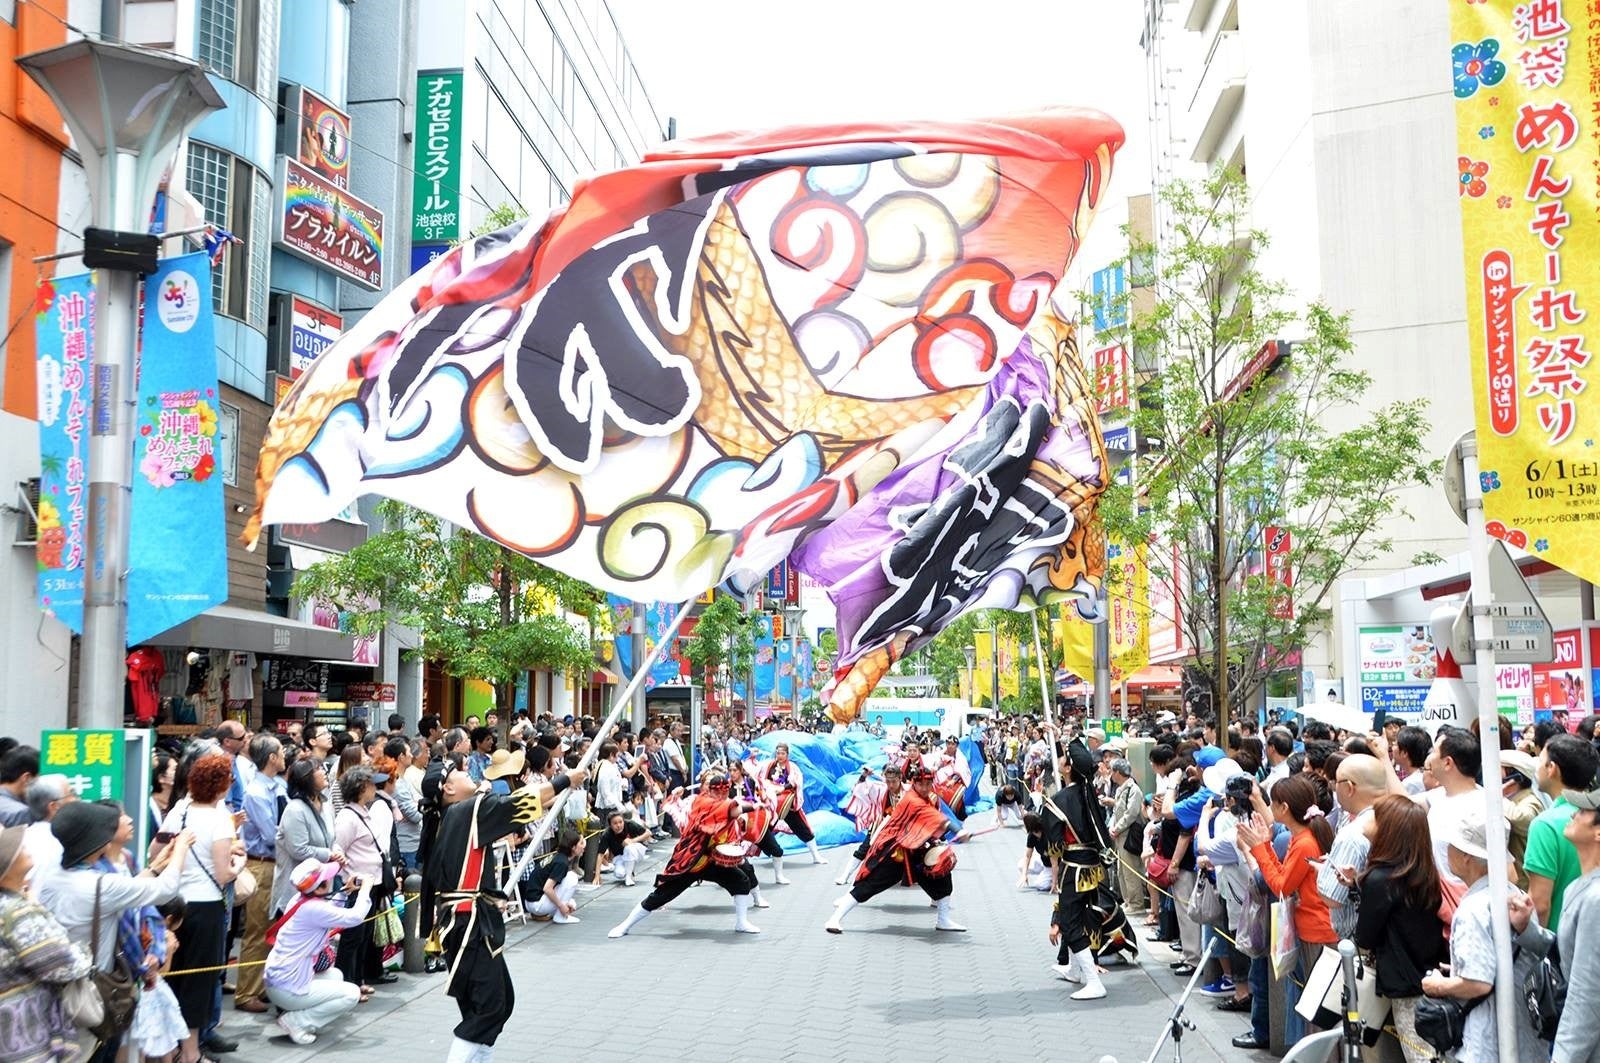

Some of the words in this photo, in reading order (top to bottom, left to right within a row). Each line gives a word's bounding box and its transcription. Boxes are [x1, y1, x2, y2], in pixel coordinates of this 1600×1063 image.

[424, 78, 453, 211] ナガセPCスクール
[341, 203, 381, 230] マッサージ
[416, 214, 456, 228] 池袋校
[291, 208, 377, 265] プラカイルン
[424, 227, 445, 240] 3F
[369, 271, 381, 285] 4F
[1490, 266, 1505, 277] in
[306, 310, 327, 332] 3F
[1489, 284, 1513, 423] サンシャイン60通り
[160, 410, 200, 435] 沖縄
[148, 437, 212, 455] めんそーれ
[1364, 688, 1384, 701] B2F
[47, 733, 113, 765] 悪質
